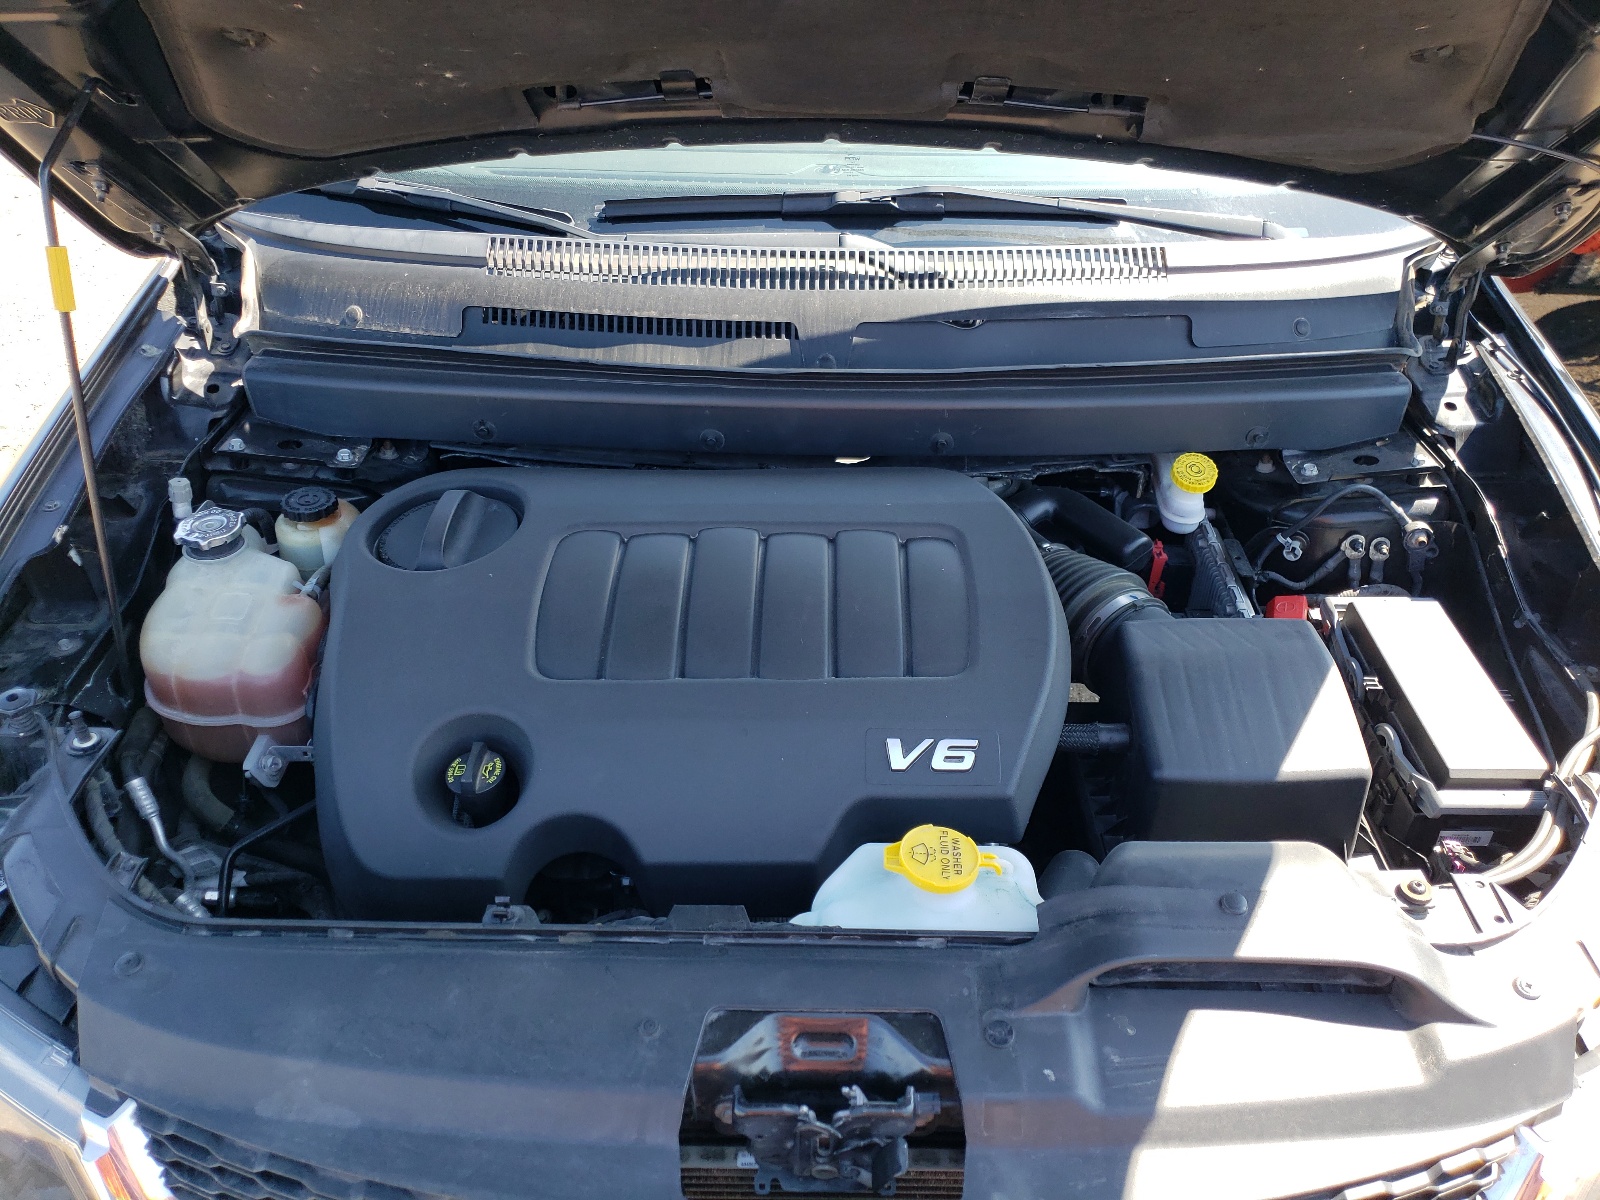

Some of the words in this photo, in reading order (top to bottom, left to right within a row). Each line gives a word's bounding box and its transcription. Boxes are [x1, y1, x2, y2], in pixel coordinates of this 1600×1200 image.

[885, 738, 980, 772] V6
[487, 776, 497, 784] OIL
[939, 830, 950, 856] FLUID
[940, 857, 951, 880] ONLY
[951, 837, 963, 876] WASHER
